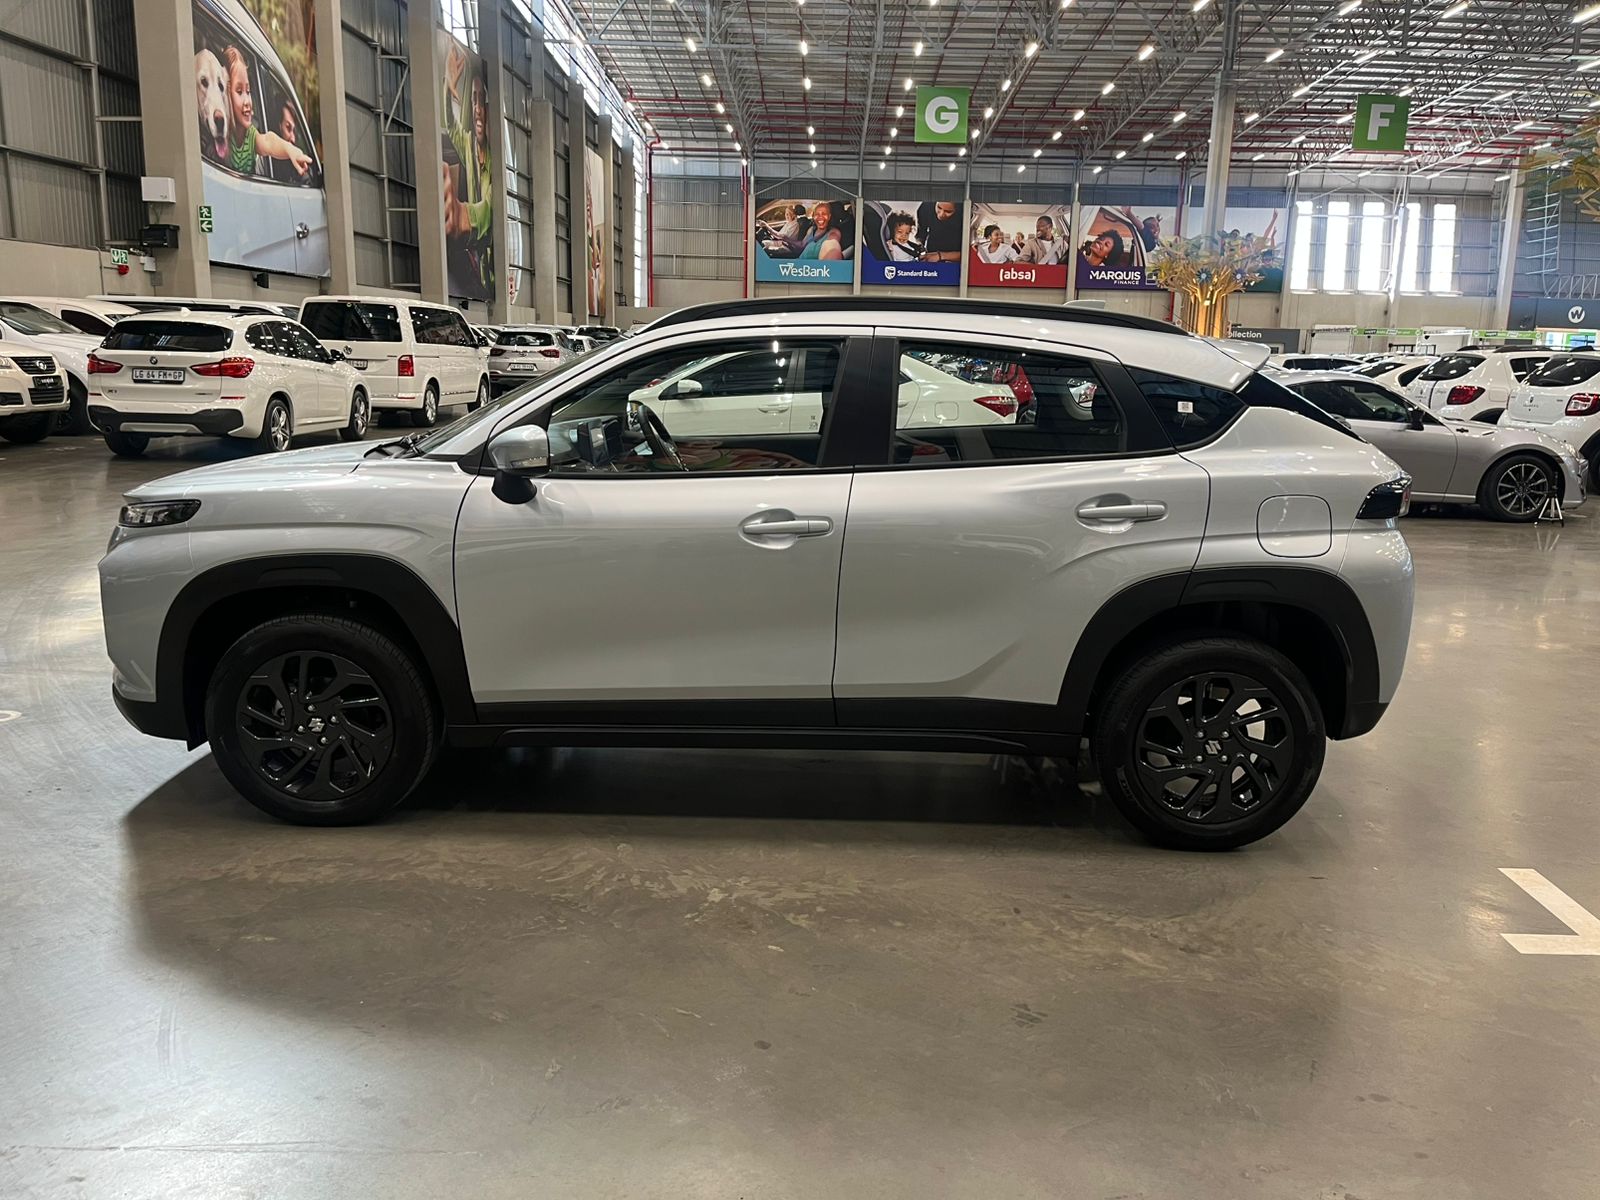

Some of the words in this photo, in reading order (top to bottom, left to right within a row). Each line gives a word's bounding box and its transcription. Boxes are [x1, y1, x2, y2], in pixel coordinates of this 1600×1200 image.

[925, 96, 959, 134] G
[1367, 104, 1396, 140] F
[779, 262, 830, 278] WesBank
[897, 269, 923, 277] Standard
[999, 267, 1036, 282] (absa)
[1089, 270, 1141, 280] MARQUIS
[1227, 330, 1262, 339] ollection
[173, 371, 182, 380] GP
